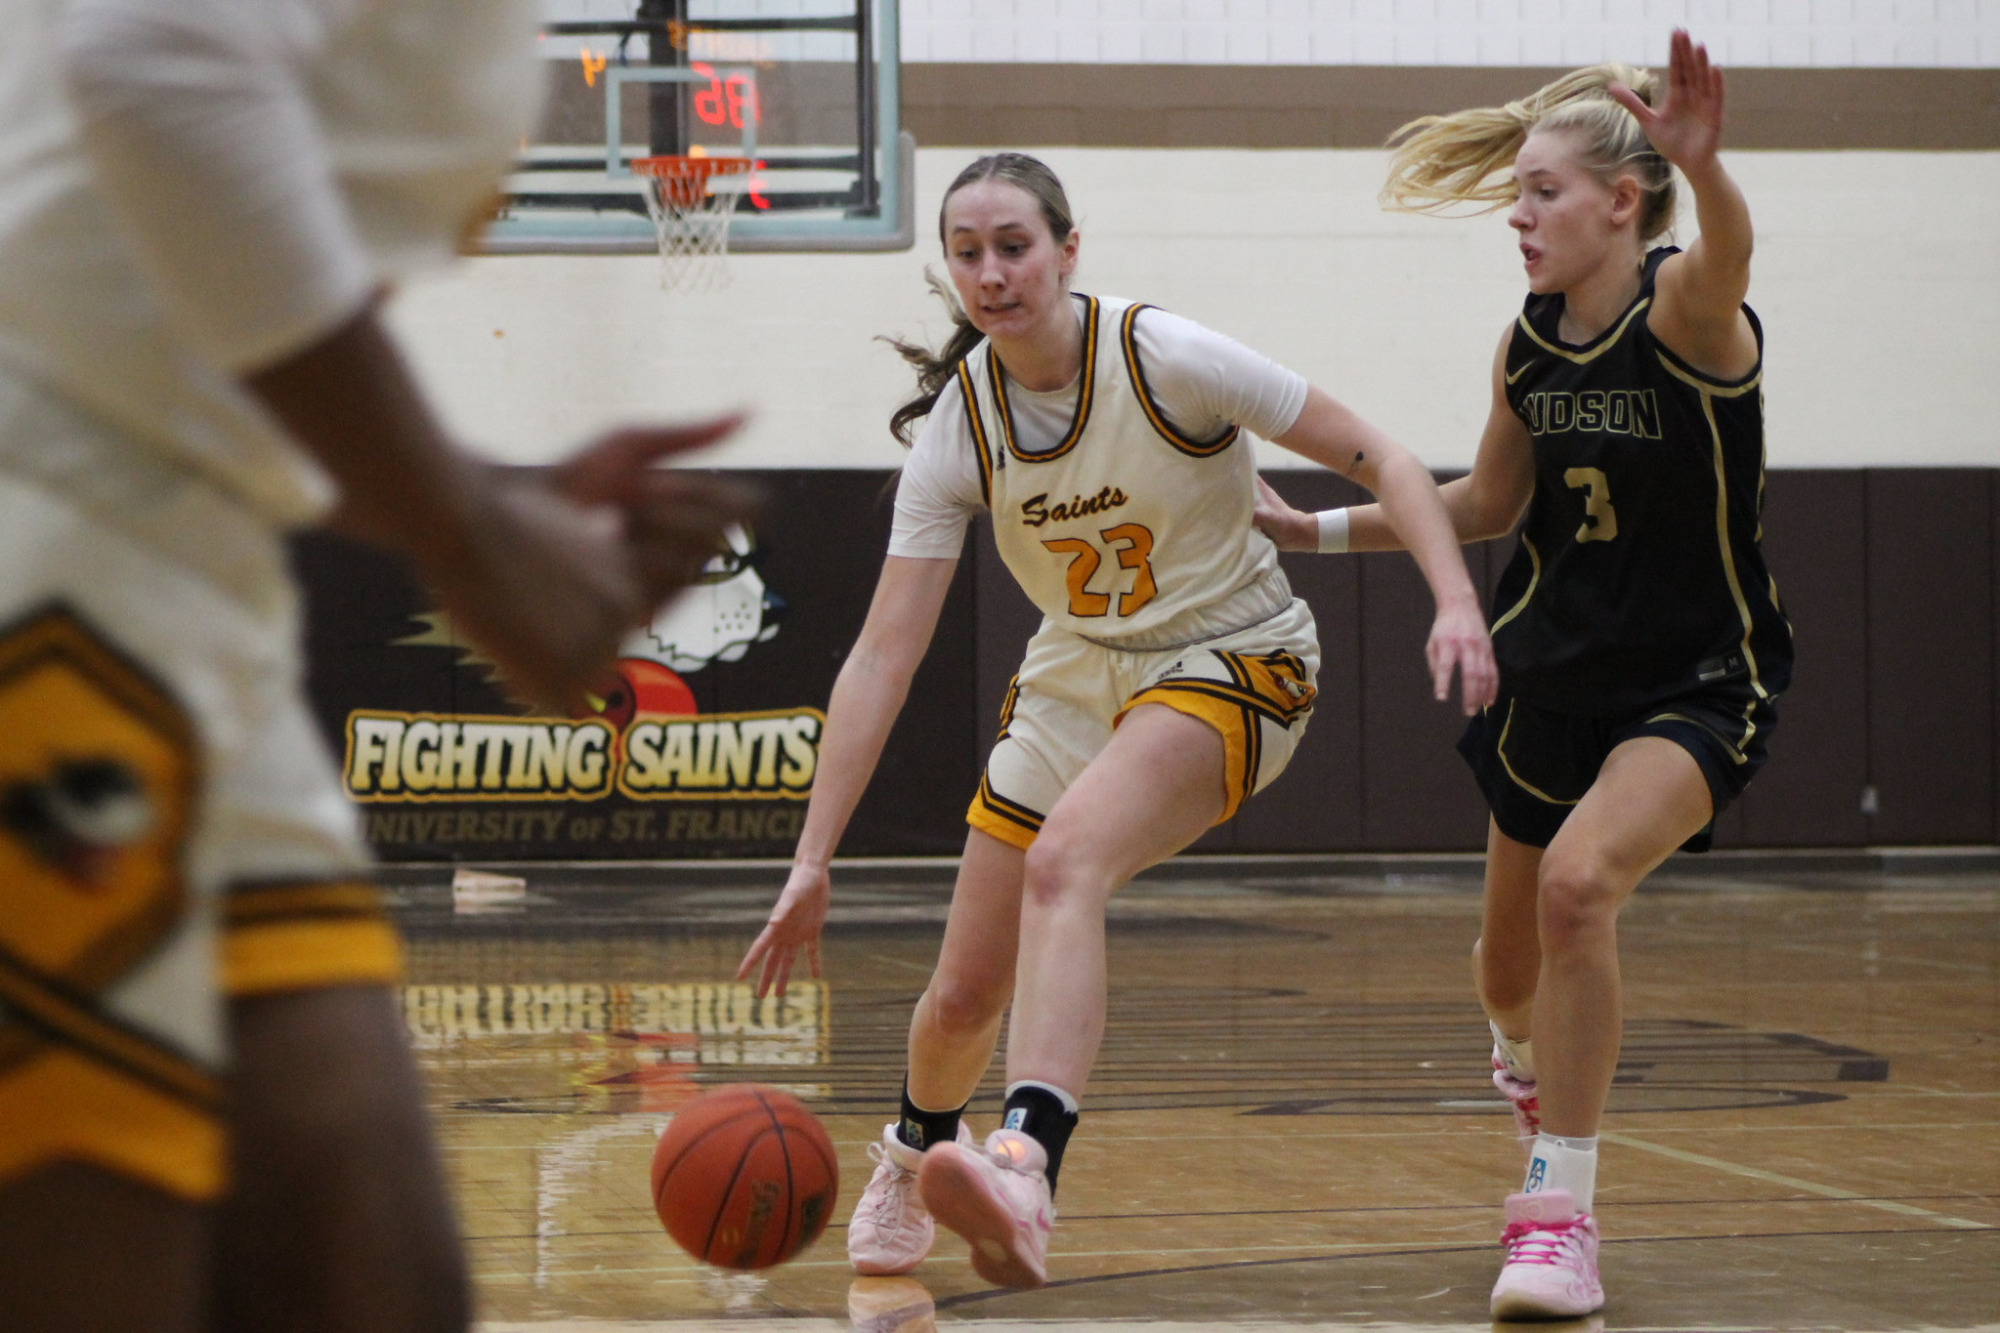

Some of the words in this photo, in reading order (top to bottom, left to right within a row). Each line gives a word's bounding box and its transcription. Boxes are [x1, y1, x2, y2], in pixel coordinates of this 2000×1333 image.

[1519, 388, 1662, 440] UDSON
[1021, 485, 1130, 527] Saints
[1563, 466, 1618, 544] 3
[1041, 522, 1158, 618] 23
[349, 716, 606, 792] FIGHTING
[623, 714, 819, 790] SAINTS
[611, 810, 662, 844] ST.
[669, 809, 806, 842] FRANCI
